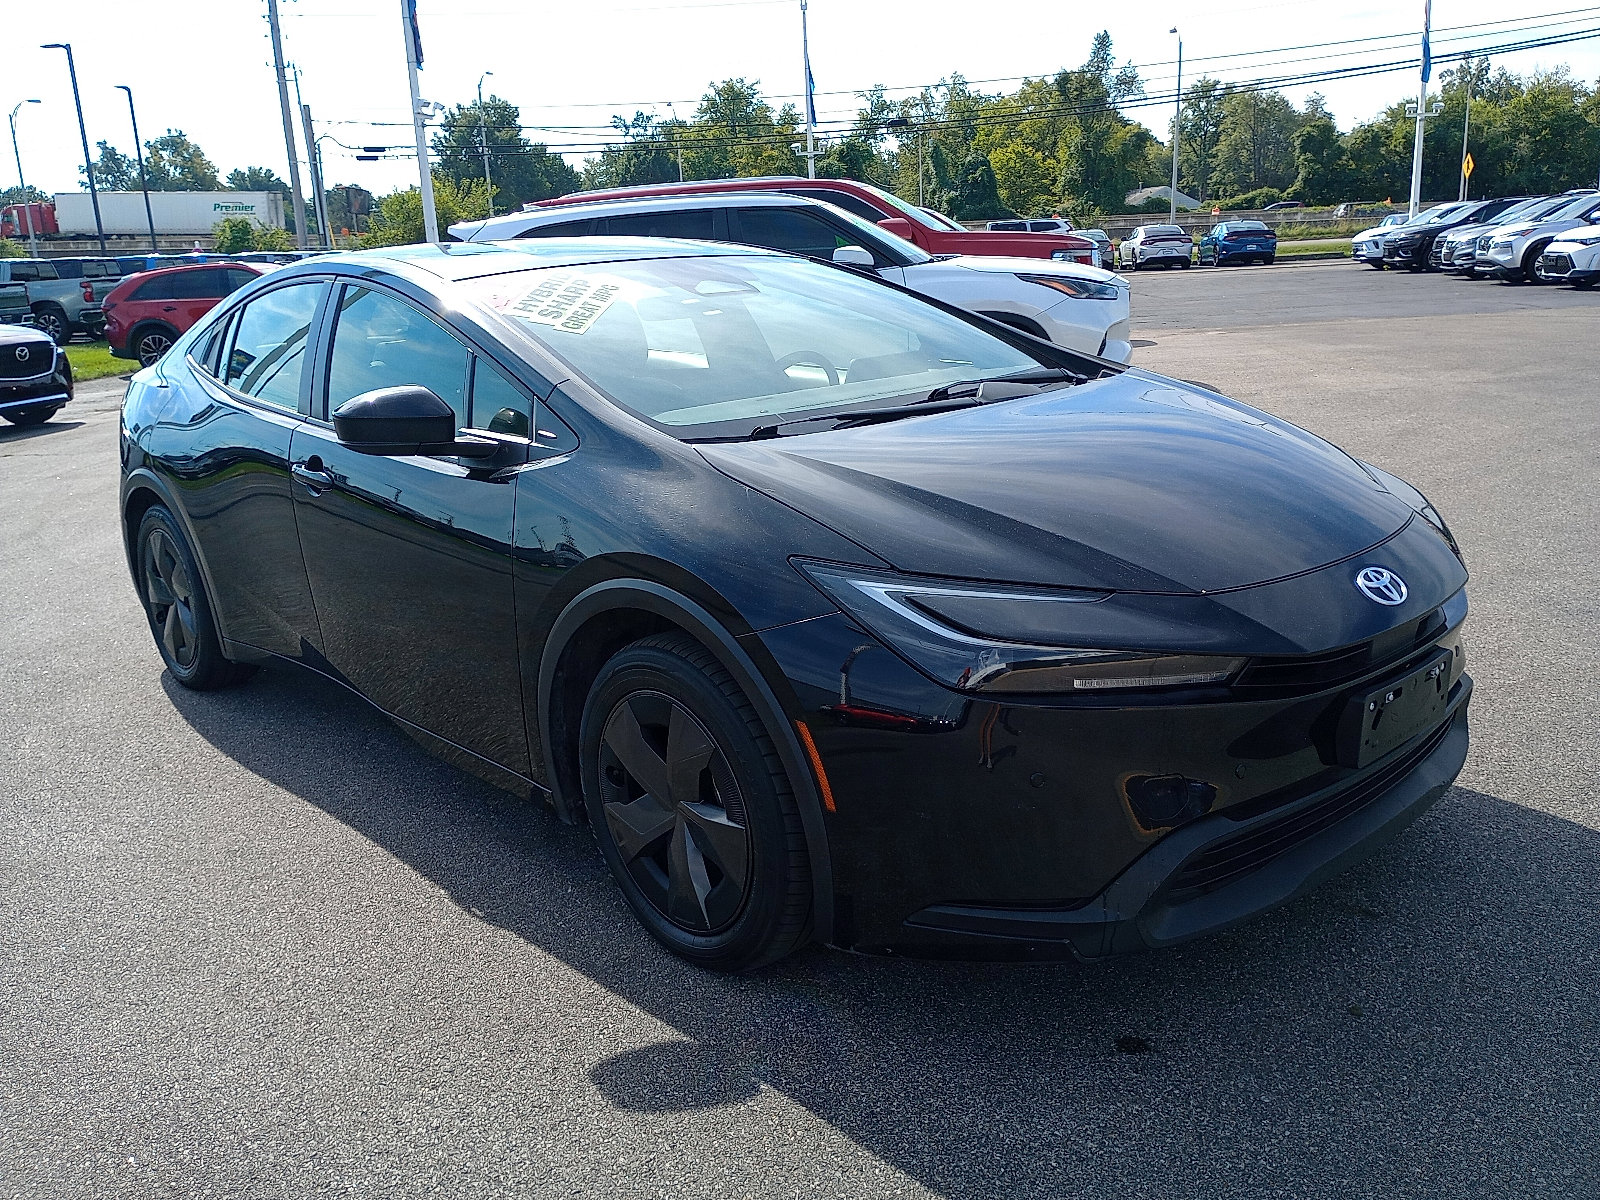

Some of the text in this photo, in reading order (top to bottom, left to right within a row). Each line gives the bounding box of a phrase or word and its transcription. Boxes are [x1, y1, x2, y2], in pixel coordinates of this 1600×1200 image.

[213, 203, 256, 211] Premier
[537, 279, 591, 320] SHARP
[561, 284, 620, 330] GREAT MPG
